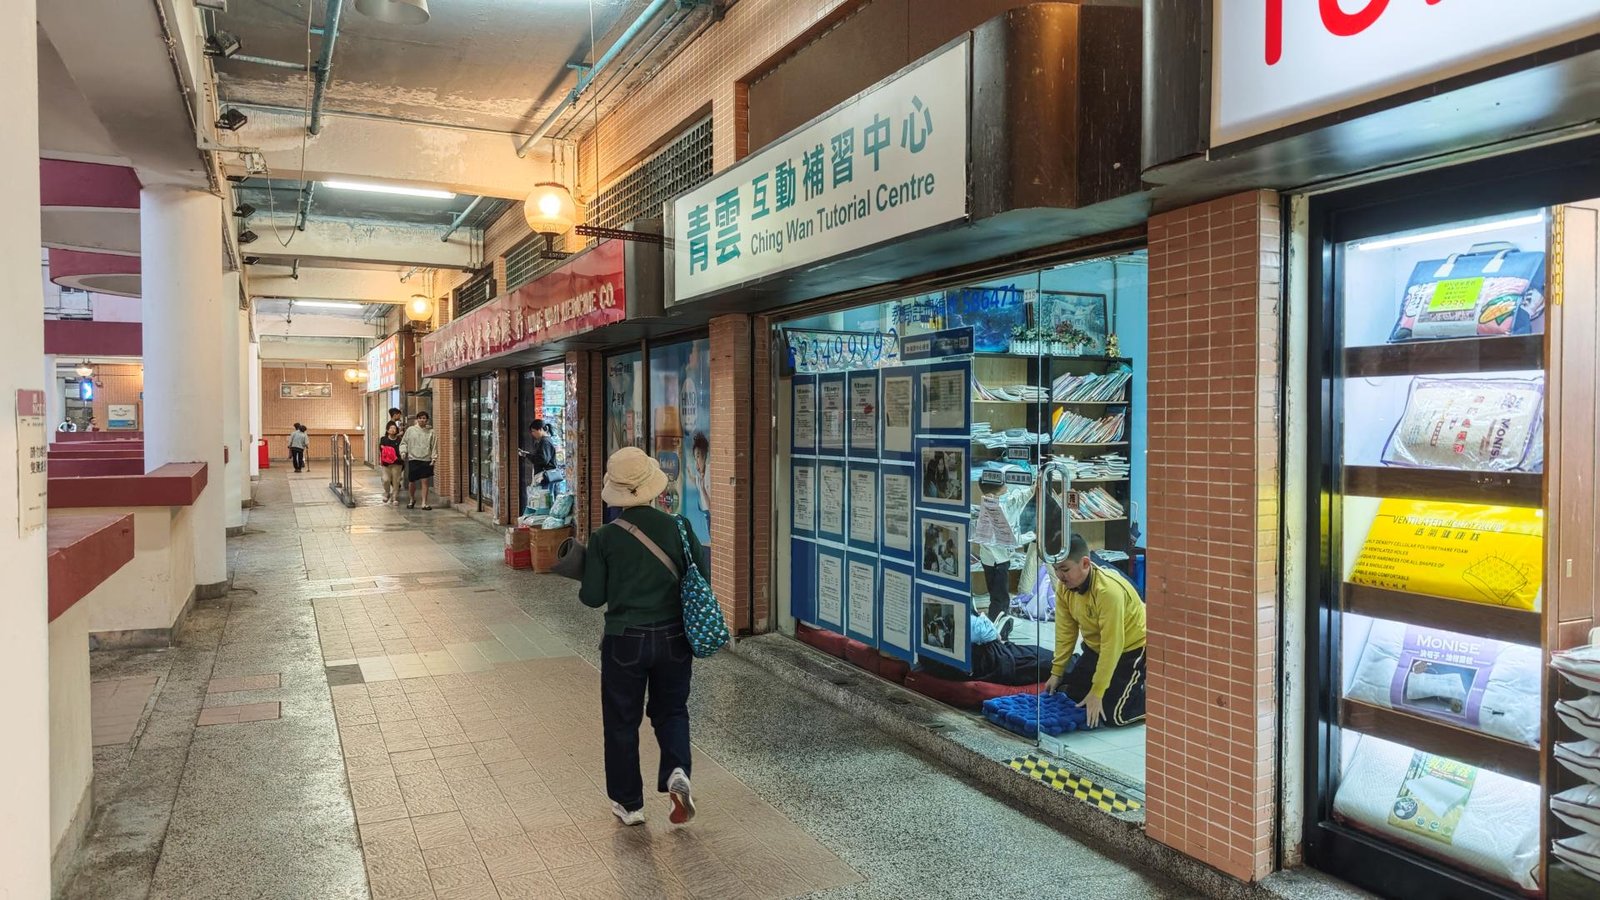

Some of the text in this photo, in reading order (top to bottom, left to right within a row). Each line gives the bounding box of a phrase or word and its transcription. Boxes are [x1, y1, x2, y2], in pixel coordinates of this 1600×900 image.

[686, 95, 934, 276] 青雲 互動補習中心
[750, 172, 935, 256] Ching Wan Tutorial Centre
[600, 281, 616, 309] CO.
[1416, 634, 1481, 655] MONISE
